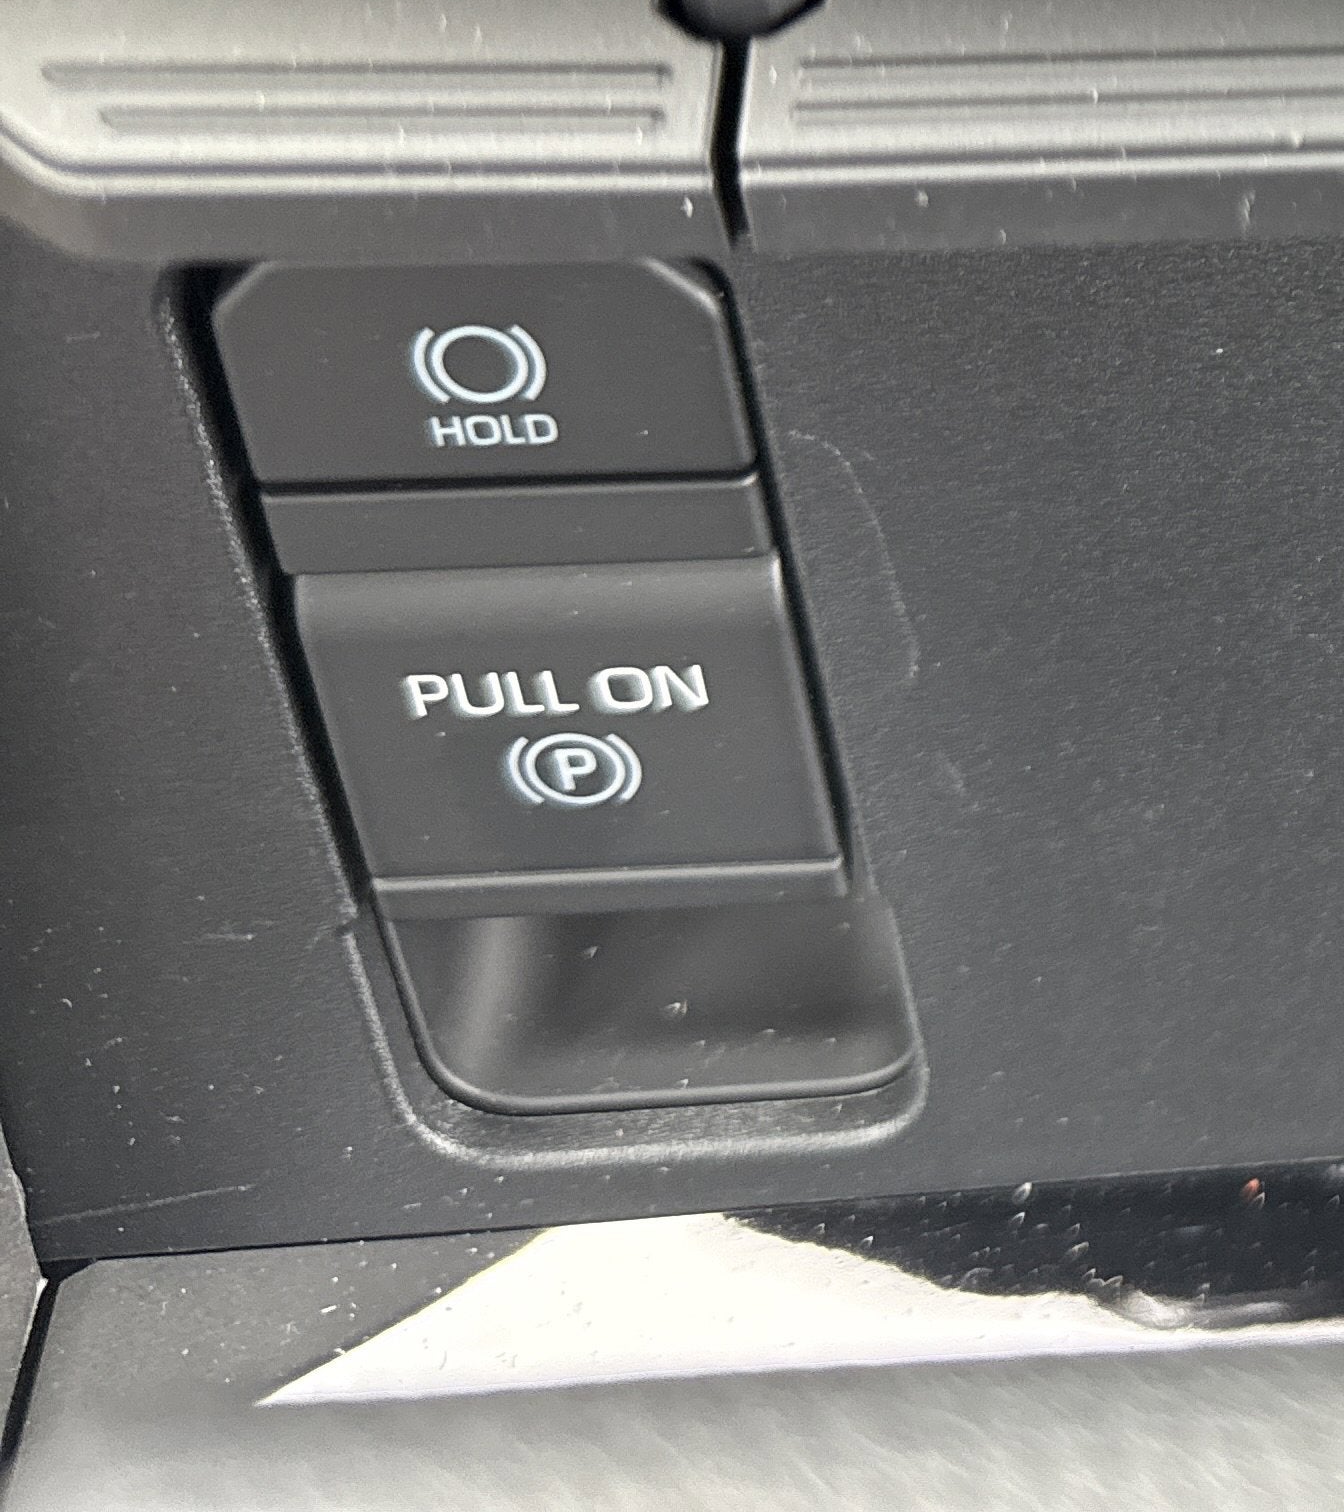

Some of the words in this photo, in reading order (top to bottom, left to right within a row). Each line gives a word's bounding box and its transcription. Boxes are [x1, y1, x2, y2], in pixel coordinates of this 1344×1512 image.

[431, 414, 558, 447] HOLD
[405, 670, 580, 718] PULL
[591, 664, 709, 713] ON
[553, 748, 597, 791] P
